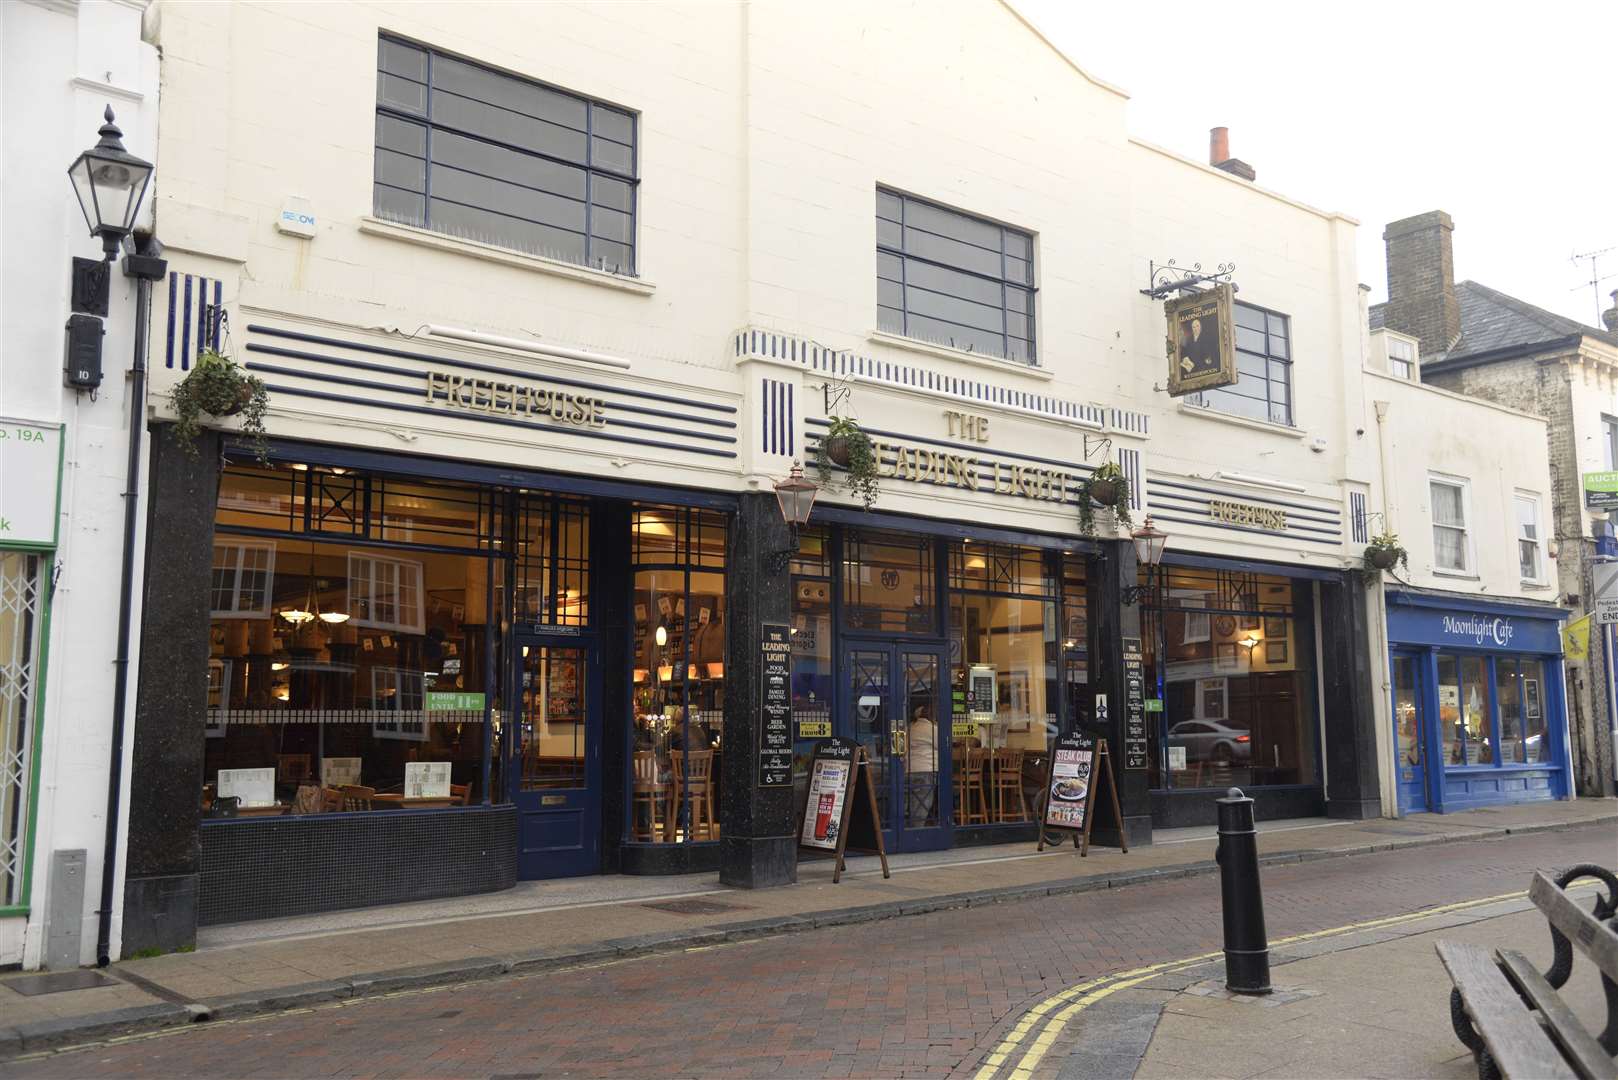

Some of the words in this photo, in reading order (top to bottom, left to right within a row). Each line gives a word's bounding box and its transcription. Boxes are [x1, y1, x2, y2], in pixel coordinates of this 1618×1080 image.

[425, 371, 607, 428] FREEHOUSE
[16, 428, 44, 443] 19A
[943, 410, 990, 442] THE
[872, 442, 980, 492] EADING
[993, 461, 1072, 503] LIGHT
[1208, 499, 1289, 531] FREEHOUSE
[770, 633, 782, 641] THE
[1443, 614, 1492, 645] Moonlight
[762, 642, 790, 652] LEADING
[767, 653, 785, 662] LIGHT
[1056, 750, 1075, 761] STEAK
[1076, 751, 1092, 762] CLUB
